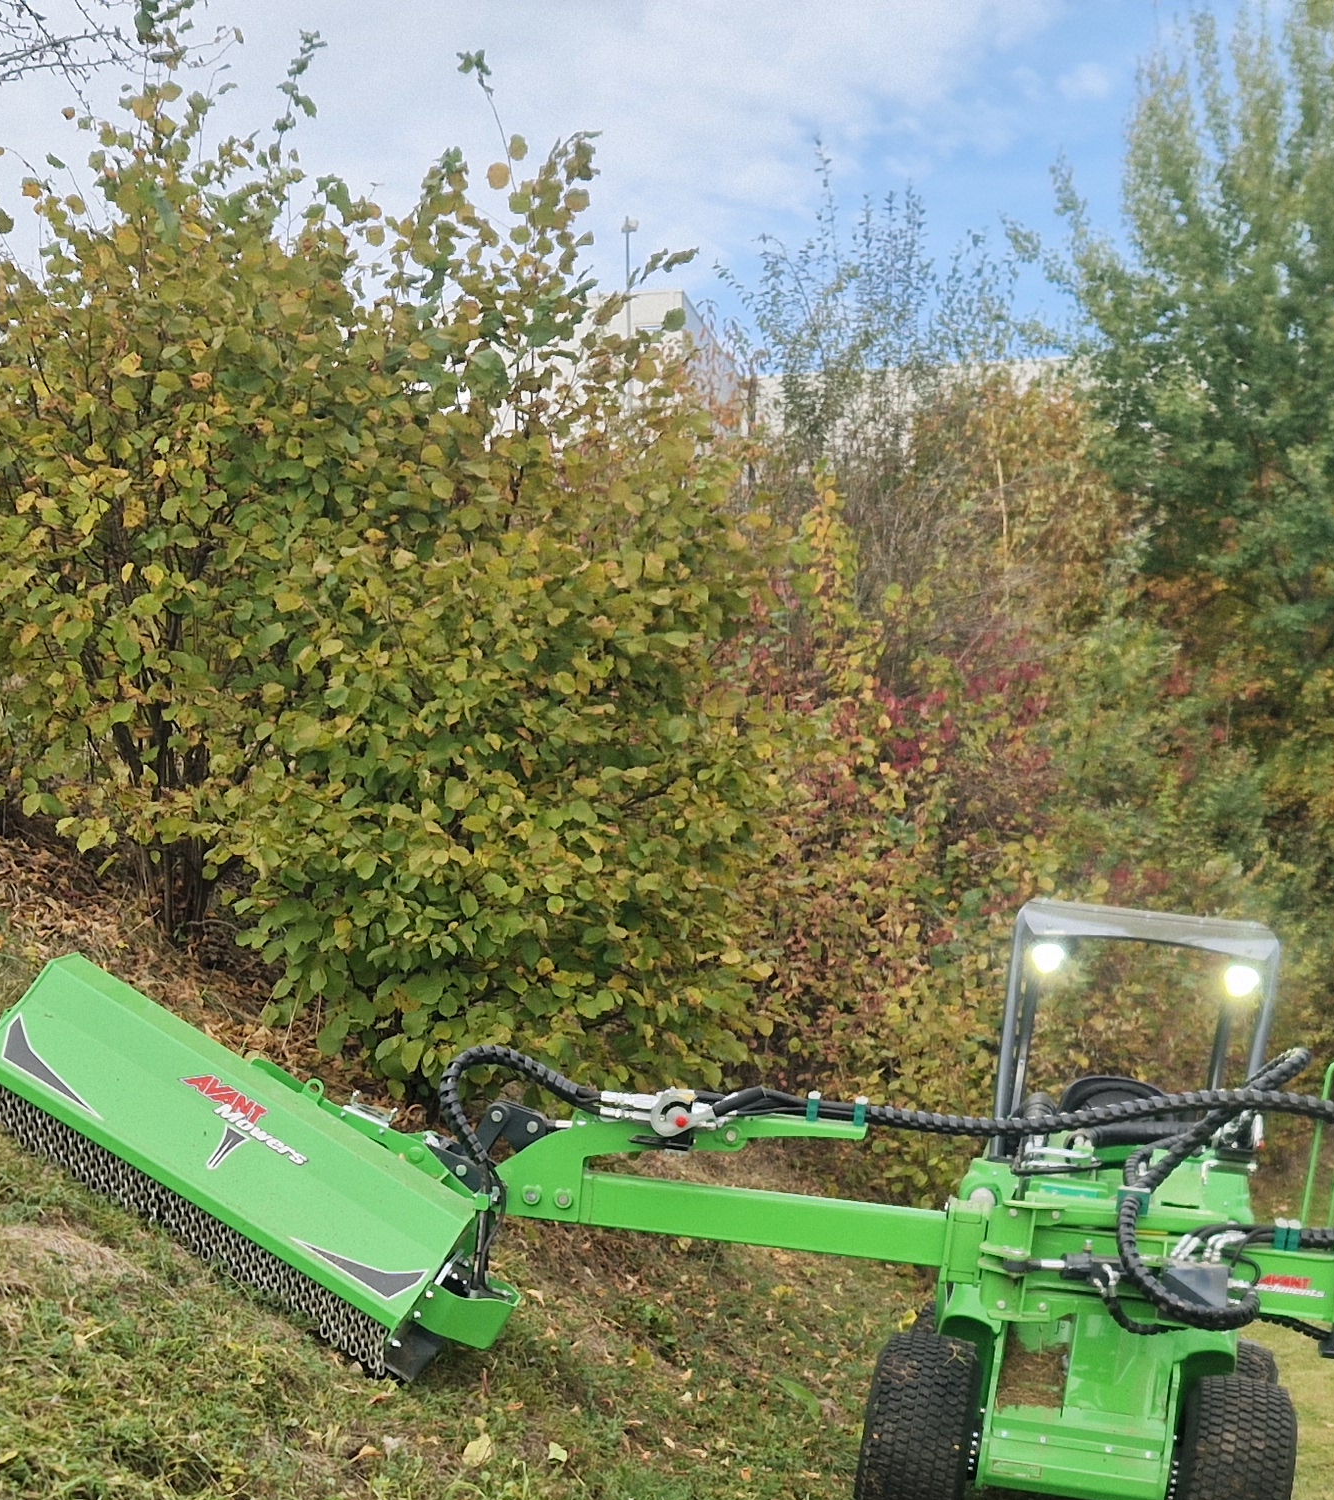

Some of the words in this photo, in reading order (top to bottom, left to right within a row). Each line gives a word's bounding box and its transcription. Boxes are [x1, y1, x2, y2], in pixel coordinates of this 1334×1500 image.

[177, 1074, 269, 1125] AVANT
[213, 1103, 309, 1166] Mowers
[1254, 1283, 1326, 1298] achments
